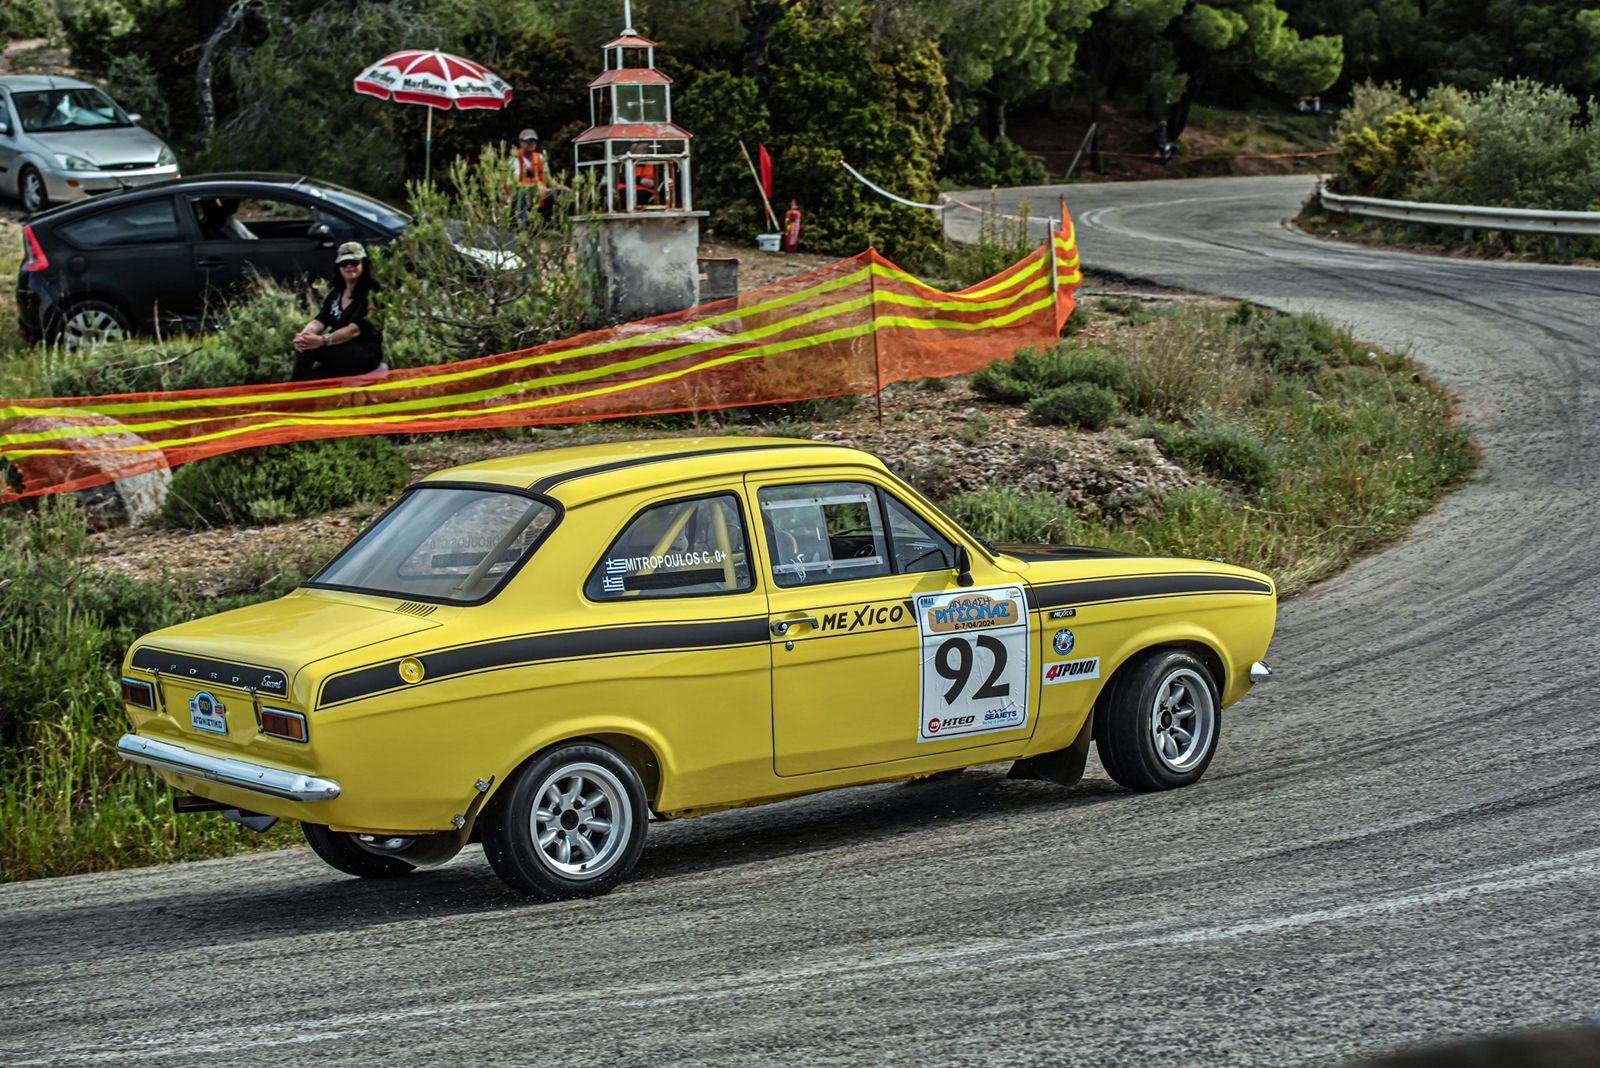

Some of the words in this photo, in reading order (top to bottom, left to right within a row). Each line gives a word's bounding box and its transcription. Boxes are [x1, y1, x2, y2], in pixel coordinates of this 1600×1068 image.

[403, 78, 447, 92] Marlboro
[625, 552, 701, 572] MITROPOULOS
[821, 605, 904, 631] MEXICO
[954, 619, 996, 630] 6-7/04/2024
[934, 634, 1010, 706] 92
[984, 710, 1017, 721] SEAJETS
